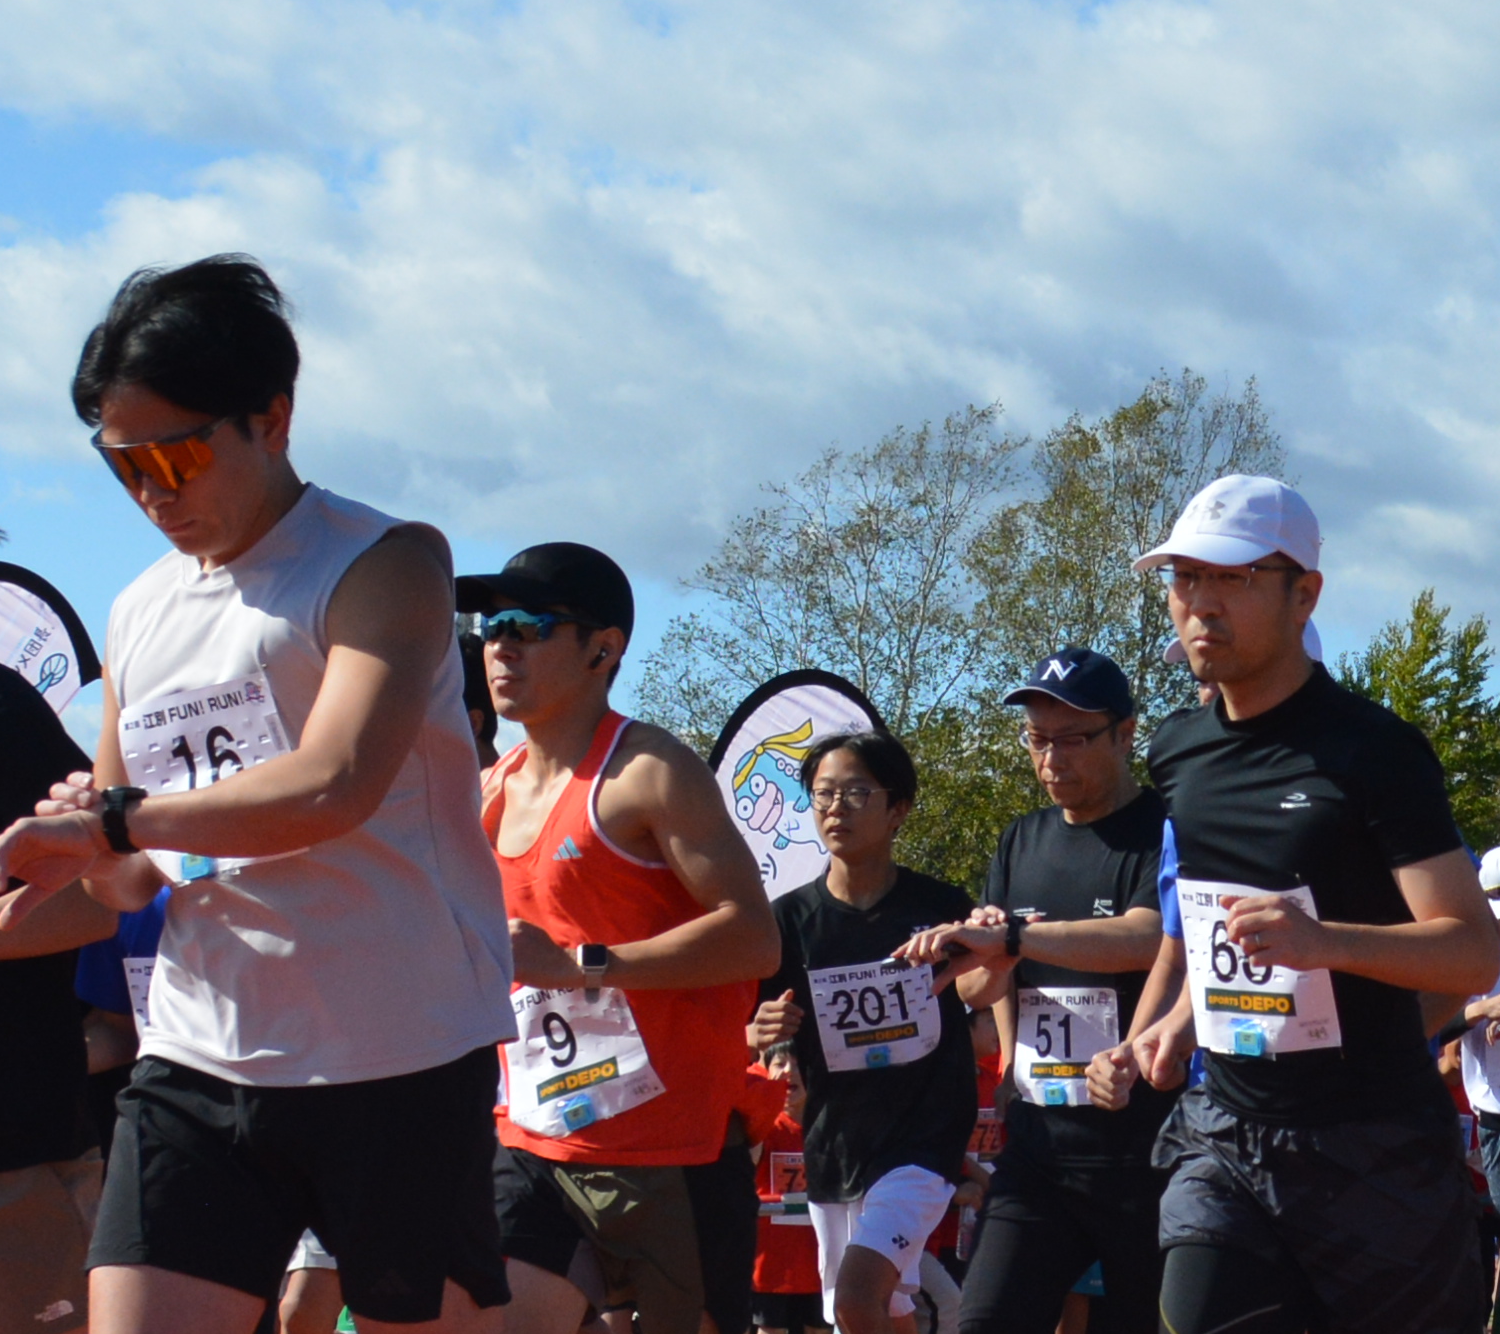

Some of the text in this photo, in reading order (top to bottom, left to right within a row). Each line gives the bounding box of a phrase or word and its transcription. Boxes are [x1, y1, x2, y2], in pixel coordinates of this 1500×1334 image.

[169, 700, 204, 722] FUN!
[208, 690, 245, 712] RUN!
[171, 725, 244, 790] 16
[848, 969, 877, 982] FUN!
[831, 981, 909, 1030] 201
[1066, 995, 1095, 1006] RUN!
[1208, 995, 1291, 1013] SPORTS DEPO
[542, 1012, 577, 1068] 9
[1035, 1013, 1071, 1058] 51
[565, 1063, 615, 1090] DEPO
